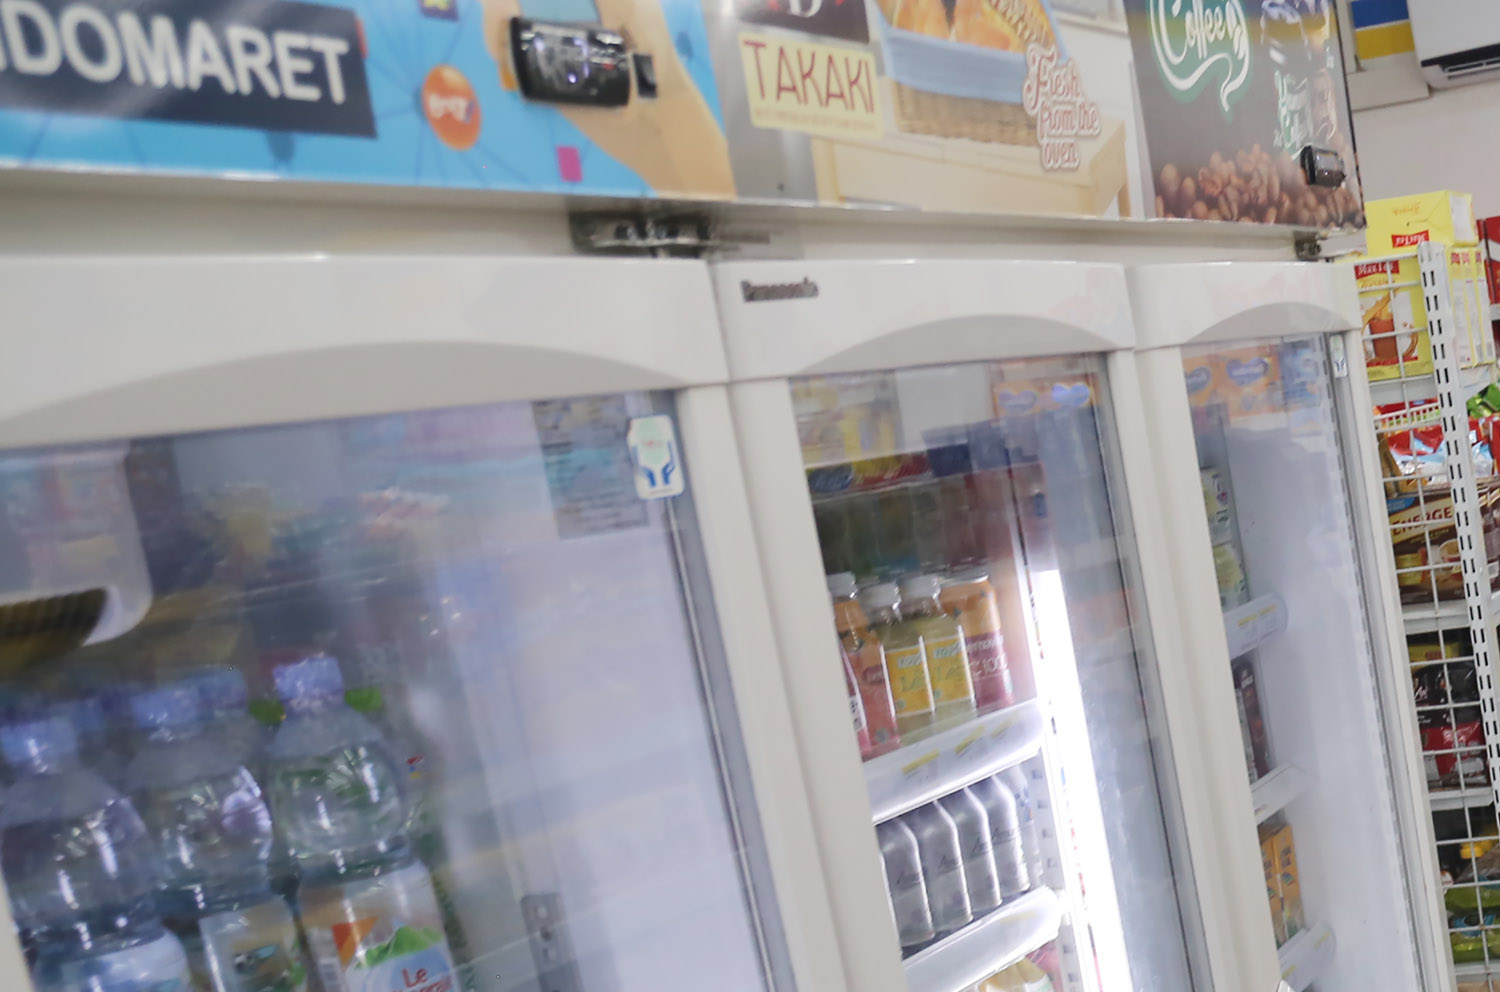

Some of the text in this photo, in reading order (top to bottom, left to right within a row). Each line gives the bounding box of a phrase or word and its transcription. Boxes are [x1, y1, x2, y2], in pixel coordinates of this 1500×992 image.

[0, 3, 349, 105] DOMARET
[743, 39, 875, 114] TAKAKI
[1043, 142, 1079, 167] oven
[1391, 505, 1453, 537] ENERGE
[402, 967, 429, 989] Le
